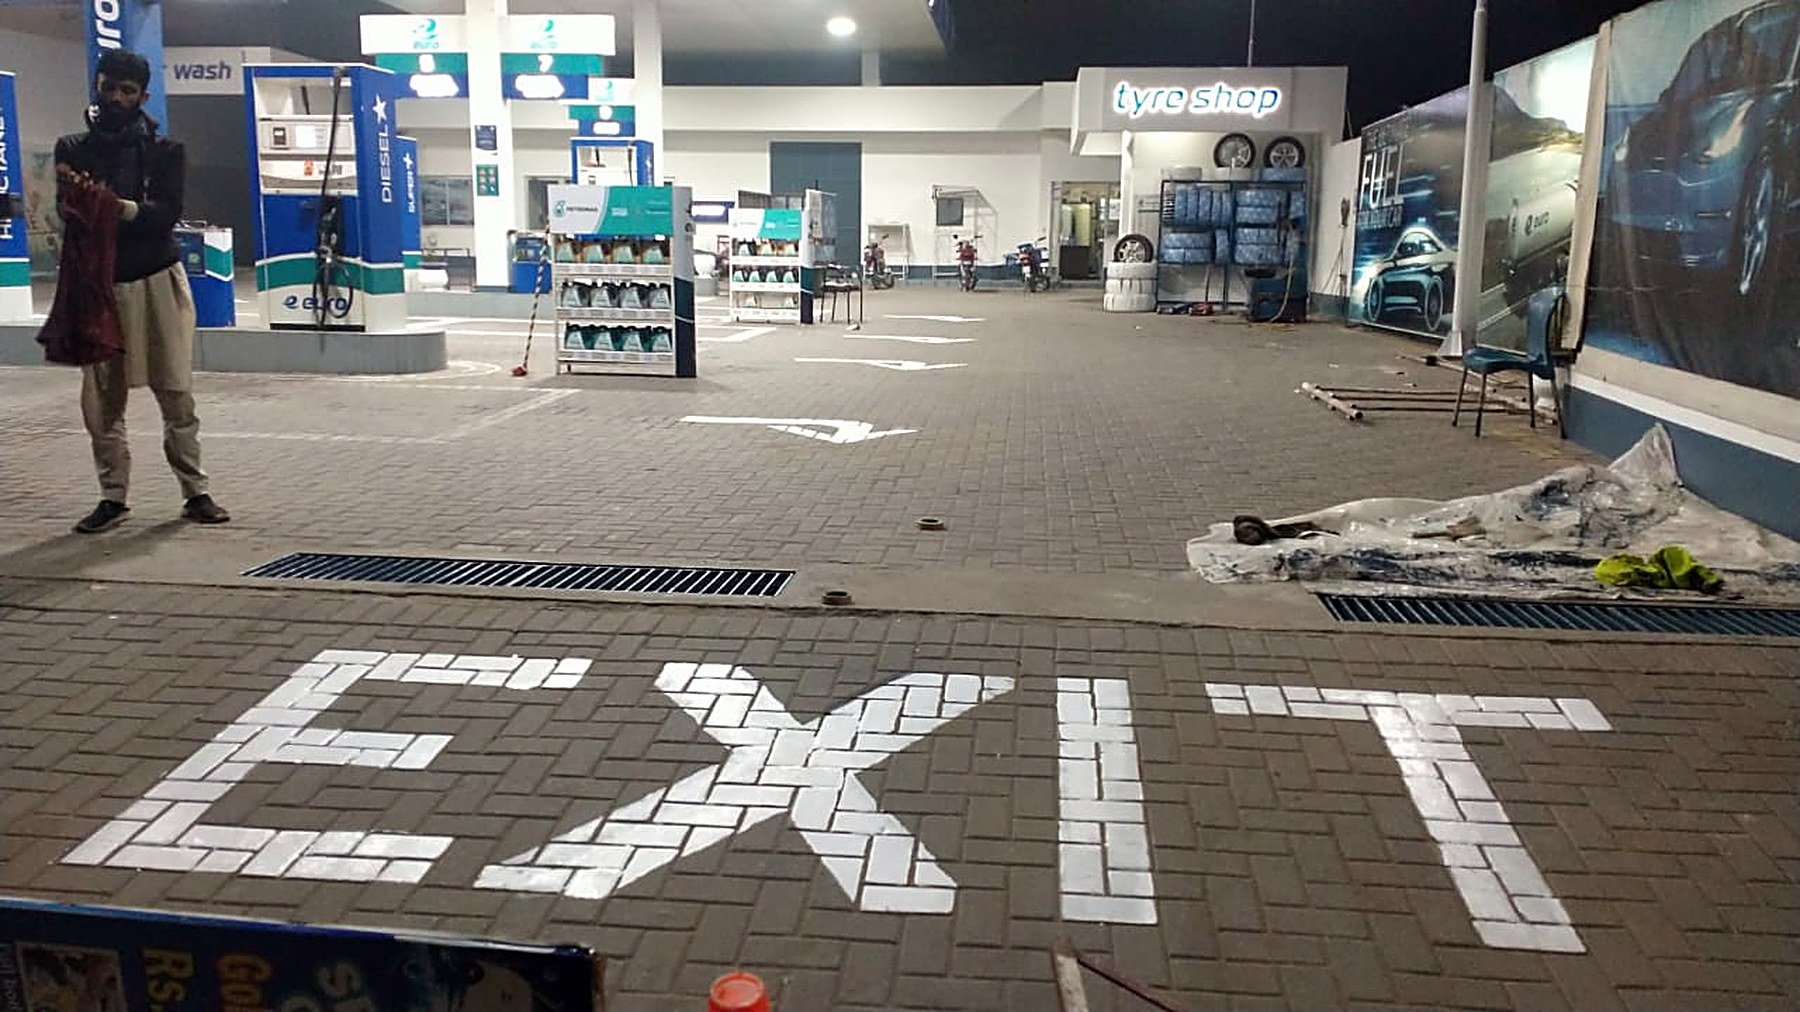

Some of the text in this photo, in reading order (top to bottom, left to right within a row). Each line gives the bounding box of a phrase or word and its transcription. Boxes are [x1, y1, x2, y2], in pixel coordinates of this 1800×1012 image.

[174, 59, 232, 80] wash
[1115, 81, 1281, 117] tyre shop
[378, 123, 393, 203] DIESEL
[1359, 140, 1405, 210] FUEL
[60, 648, 1613, 954] EXIT
